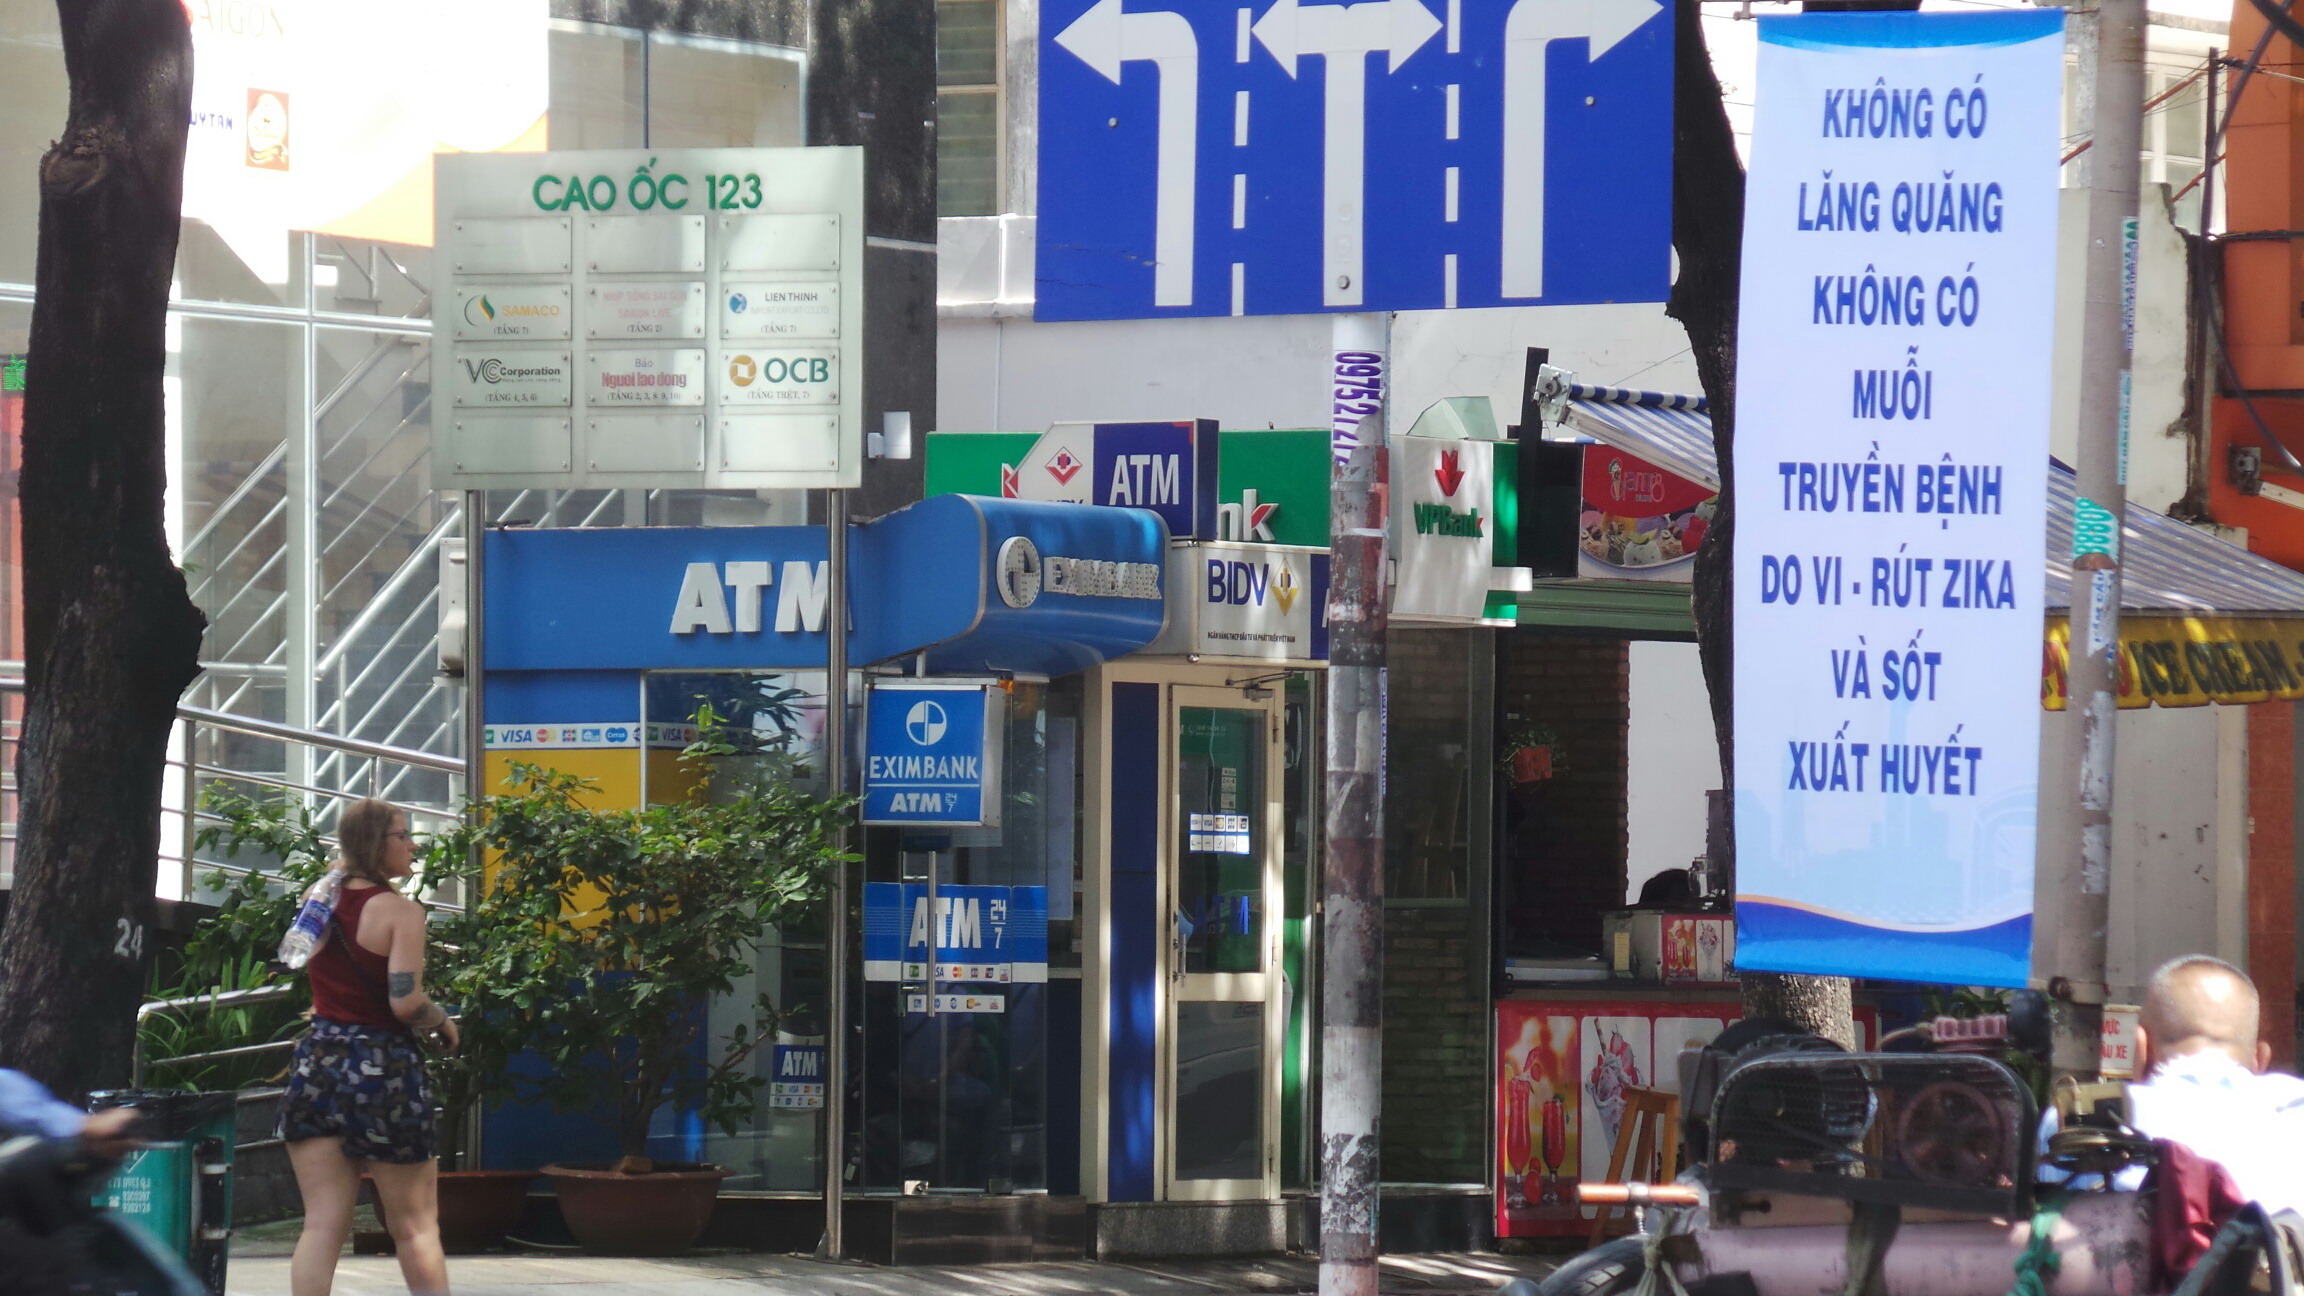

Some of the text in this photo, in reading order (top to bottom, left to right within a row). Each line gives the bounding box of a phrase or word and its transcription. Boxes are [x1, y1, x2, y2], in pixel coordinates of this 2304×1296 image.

[1823, 73, 1988, 139] KHÔNG CÓ
[533, 157, 763, 211] CAO ỐC 123
[1798, 169, 2004, 236] LĂNG QUĂNG
[502, 304, 560, 317] SAMACO
[1813, 261, 1980, 327] KHÔNG CÓ
[764, 357, 829, 383] OCB
[1853, 345, 1933, 420] MUỖI
[1109, 454, 1180, 506] ATM
[1778, 440, 2003, 530] TRUYỀN BỆNH
[1413, 501, 1485, 538] VPBank
[669, 560, 853, 634] ATM
[1044, 556, 1162, 600] EXIMBANK
[1207, 559, 1270, 607] BIDV
[1761, 554, 1802, 605] DO
[1812, 556, 1842, 605] VI
[1872, 543, 1933, 608] RÚT
[1942, 558, 2017, 609] ZIKA
[1831, 629, 1942, 701] VÀ SỐT
[2128, 640, 2190, 696] ICE
[2184, 639, 2299, 696] CREAM
[501, 729, 532, 743] VISA
[1788, 720, 1983, 796] XUẤT HUYẾT
[869, 755, 979, 779] EXIMBANK
[889, 792, 942, 813] ATM
[908, 896, 982, 949] ATM
[990, 899, 1007, 921] 24
[113, 917, 143, 960] 24
[994, 927, 1002, 949] 7
[781, 1050, 817, 1077] ATM
[2116, 1045, 2128, 1059] XE
